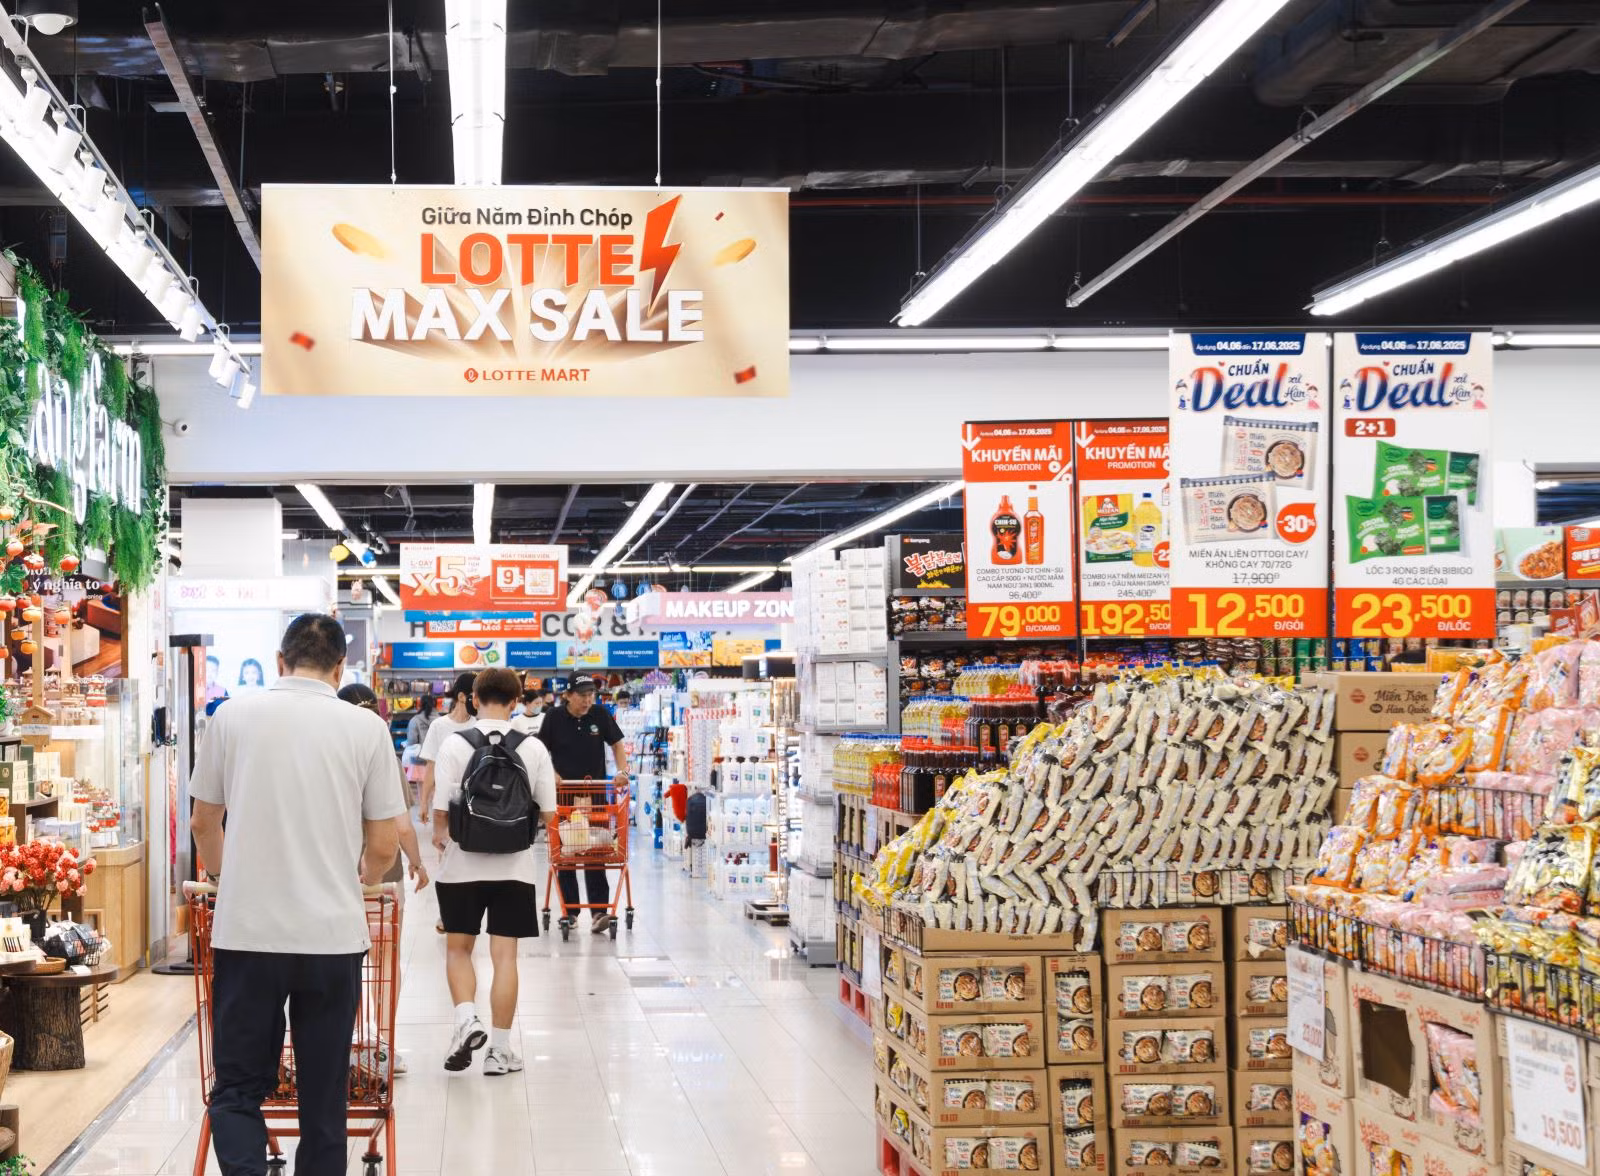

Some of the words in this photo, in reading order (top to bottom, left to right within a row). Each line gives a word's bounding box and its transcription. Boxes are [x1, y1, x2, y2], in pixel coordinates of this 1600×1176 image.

[421, 207, 472, 227] Giữa
[476, 207, 524, 227] Năm
[526, 206, 576, 227] Đỉnh
[579, 207, 633, 230] Chóp
[420, 232, 635, 287] LOTTE
[351, 288, 512, 342] MAX
[529, 288, 704, 342] SALE
[481, 369, 536, 382] LOTTE
[540, 368, 590, 382] MART
[1191, 362, 1288, 412] Deal
[1355, 361, 1453, 412] Deal
[1354, 420, 1387, 436] 2+1
[971, 445, 1033, 462] KHUYẾN
[1034, 444, 1063, 461] MÃI
[1085, 443, 1146, 460] KHUYẾN
[1148, 443, 1169, 459] MÃ
[993, 463, 1042, 472] PROMOTION
[1107, 461, 1156, 469] PROMOTION
[1250, 550, 1284, 558] OTTOGI
[1205, 559, 1238, 569] KHÔNG
[1239, 560, 1258, 569] CAY
[1385, 567, 1391, 575] 3
[1392, 567, 1418, 575] RONG
[32, 577, 41, 593] ý
[43, 578, 82, 592] nghĩa
[85, 578, 101, 591] to
[503, 569, 514, 584] 9
[666, 599, 745, 619] MAKEUP
[753, 600, 796, 618] ZON
[1187, 593, 1305, 637] 12,500
[1351, 594, 1472, 637] 23,500
[978, 605, 1060, 637] 79,000
[1081, 603, 1170, 636] 192,50
[1273, 619, 1304, 631] Đ/GÓI
[1026, 624, 1060, 633] Đ/COMBO
[1541, 1114, 1582, 1150] 19,500
